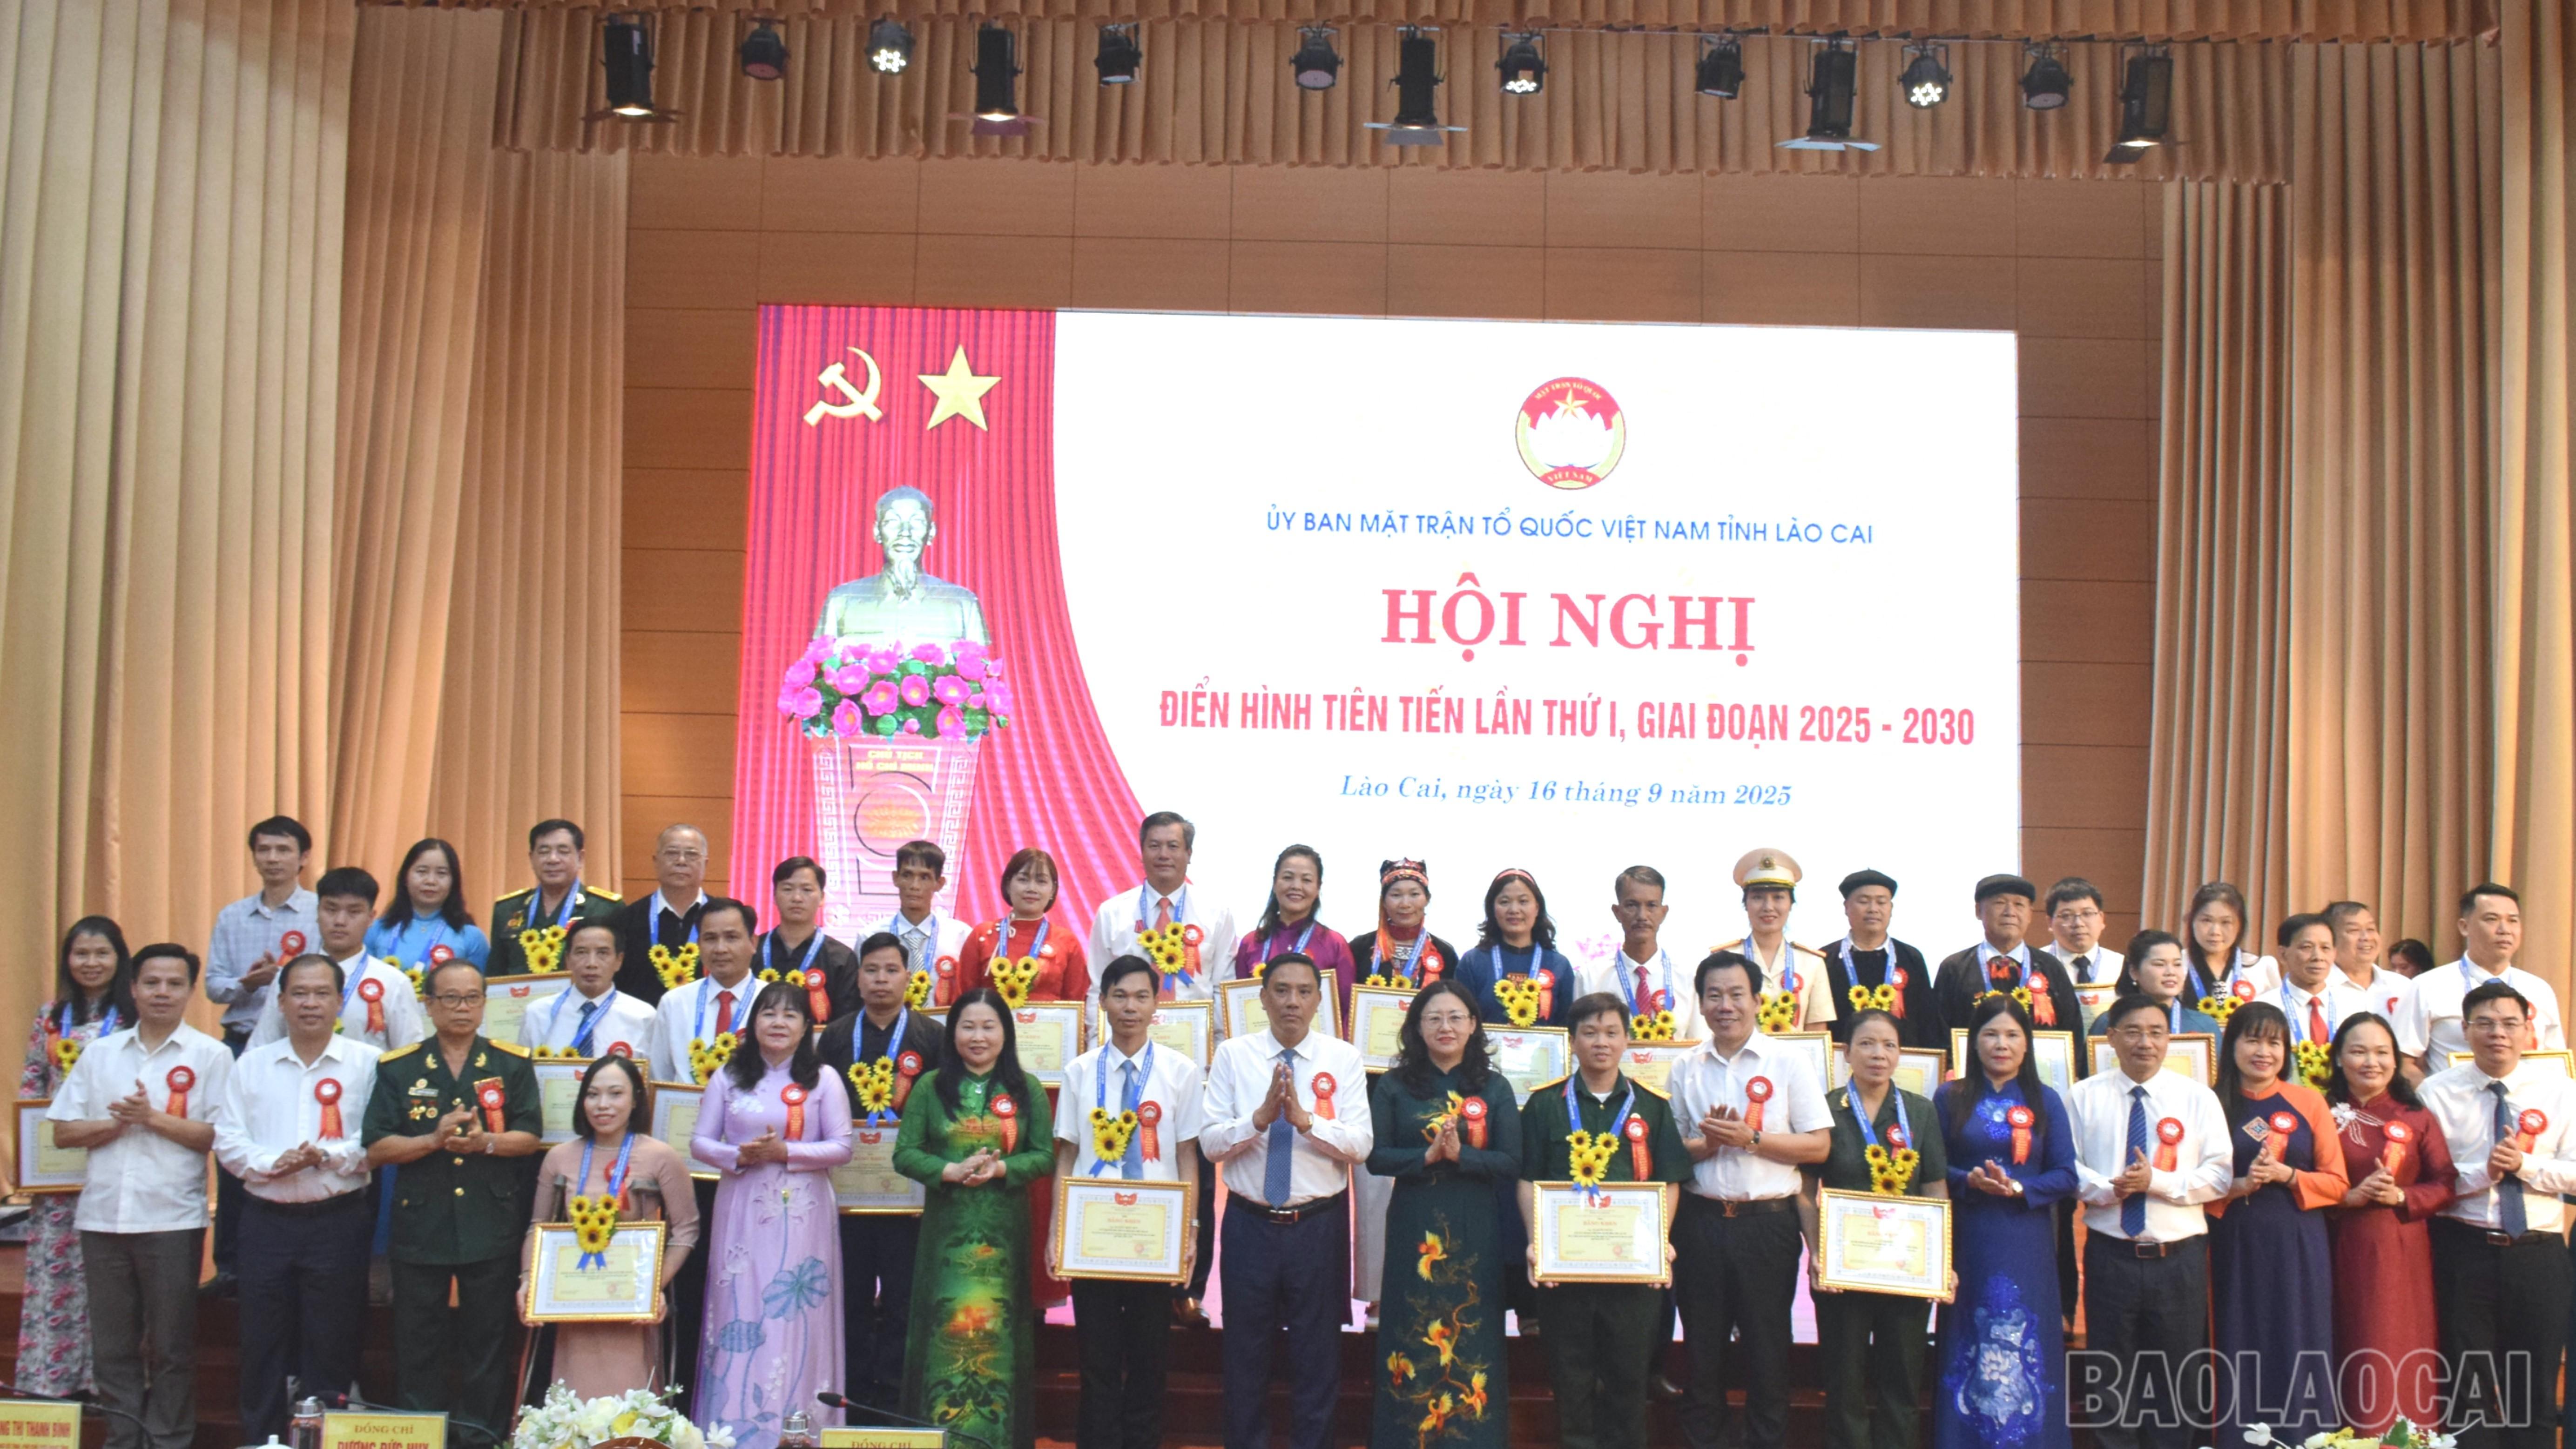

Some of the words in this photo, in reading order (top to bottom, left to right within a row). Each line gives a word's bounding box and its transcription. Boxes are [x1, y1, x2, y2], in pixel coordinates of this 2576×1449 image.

[1268, 504, 1295, 530] ỦY
[1305, 512, 1351, 532] BAN
[1361, 510, 1409, 537] MẶT
[1416, 511, 1473, 539] TRẬN
[1483, 507, 1511, 536] TỔ
[1520, 510, 1592, 538] QUỐC
[1602, 515, 1646, 543] VIỆT
[1655, 521, 1709, 539] NAM
[1718, 514, 1767, 541] TỈNH
[1777, 517, 1822, 543] LÀO
[1831, 524, 1872, 543] CAI
[1382, 572, 1527, 662] HỘI
[1550, 593, 1755, 667] NGHỊ
[1160, 676, 1229, 728] ĐIỂN
[1241, 685, 1311, 729] HÌNH
[1323, 687, 1387, 731] TIÊN
[1399, 684, 1463, 733] TIẾN
[1476, 686, 1531, 735] LẦN
[1543, 693, 1601, 736] THỨ
[1610, 701, 1625, 741] I,
[1638, 702, 1695, 738] GIAI
[1707, 704, 1787, 748] ĐOẠN
[1800, 706, 1870, 742] 2025
[1903, 708, 1974, 745] 2030
[1341, 775, 1388, 795] Lào
[1399, 777, 1446, 799] Cai,
[1458, 780, 1518, 803] ngày
[1531, 781, 1557, 799] 16
[1566, 781, 1640, 806] tháng
[1648, 783, 1662, 802] 9
[1671, 786, 1725, 803] năm
[1734, 785, 1791, 805] 2025
